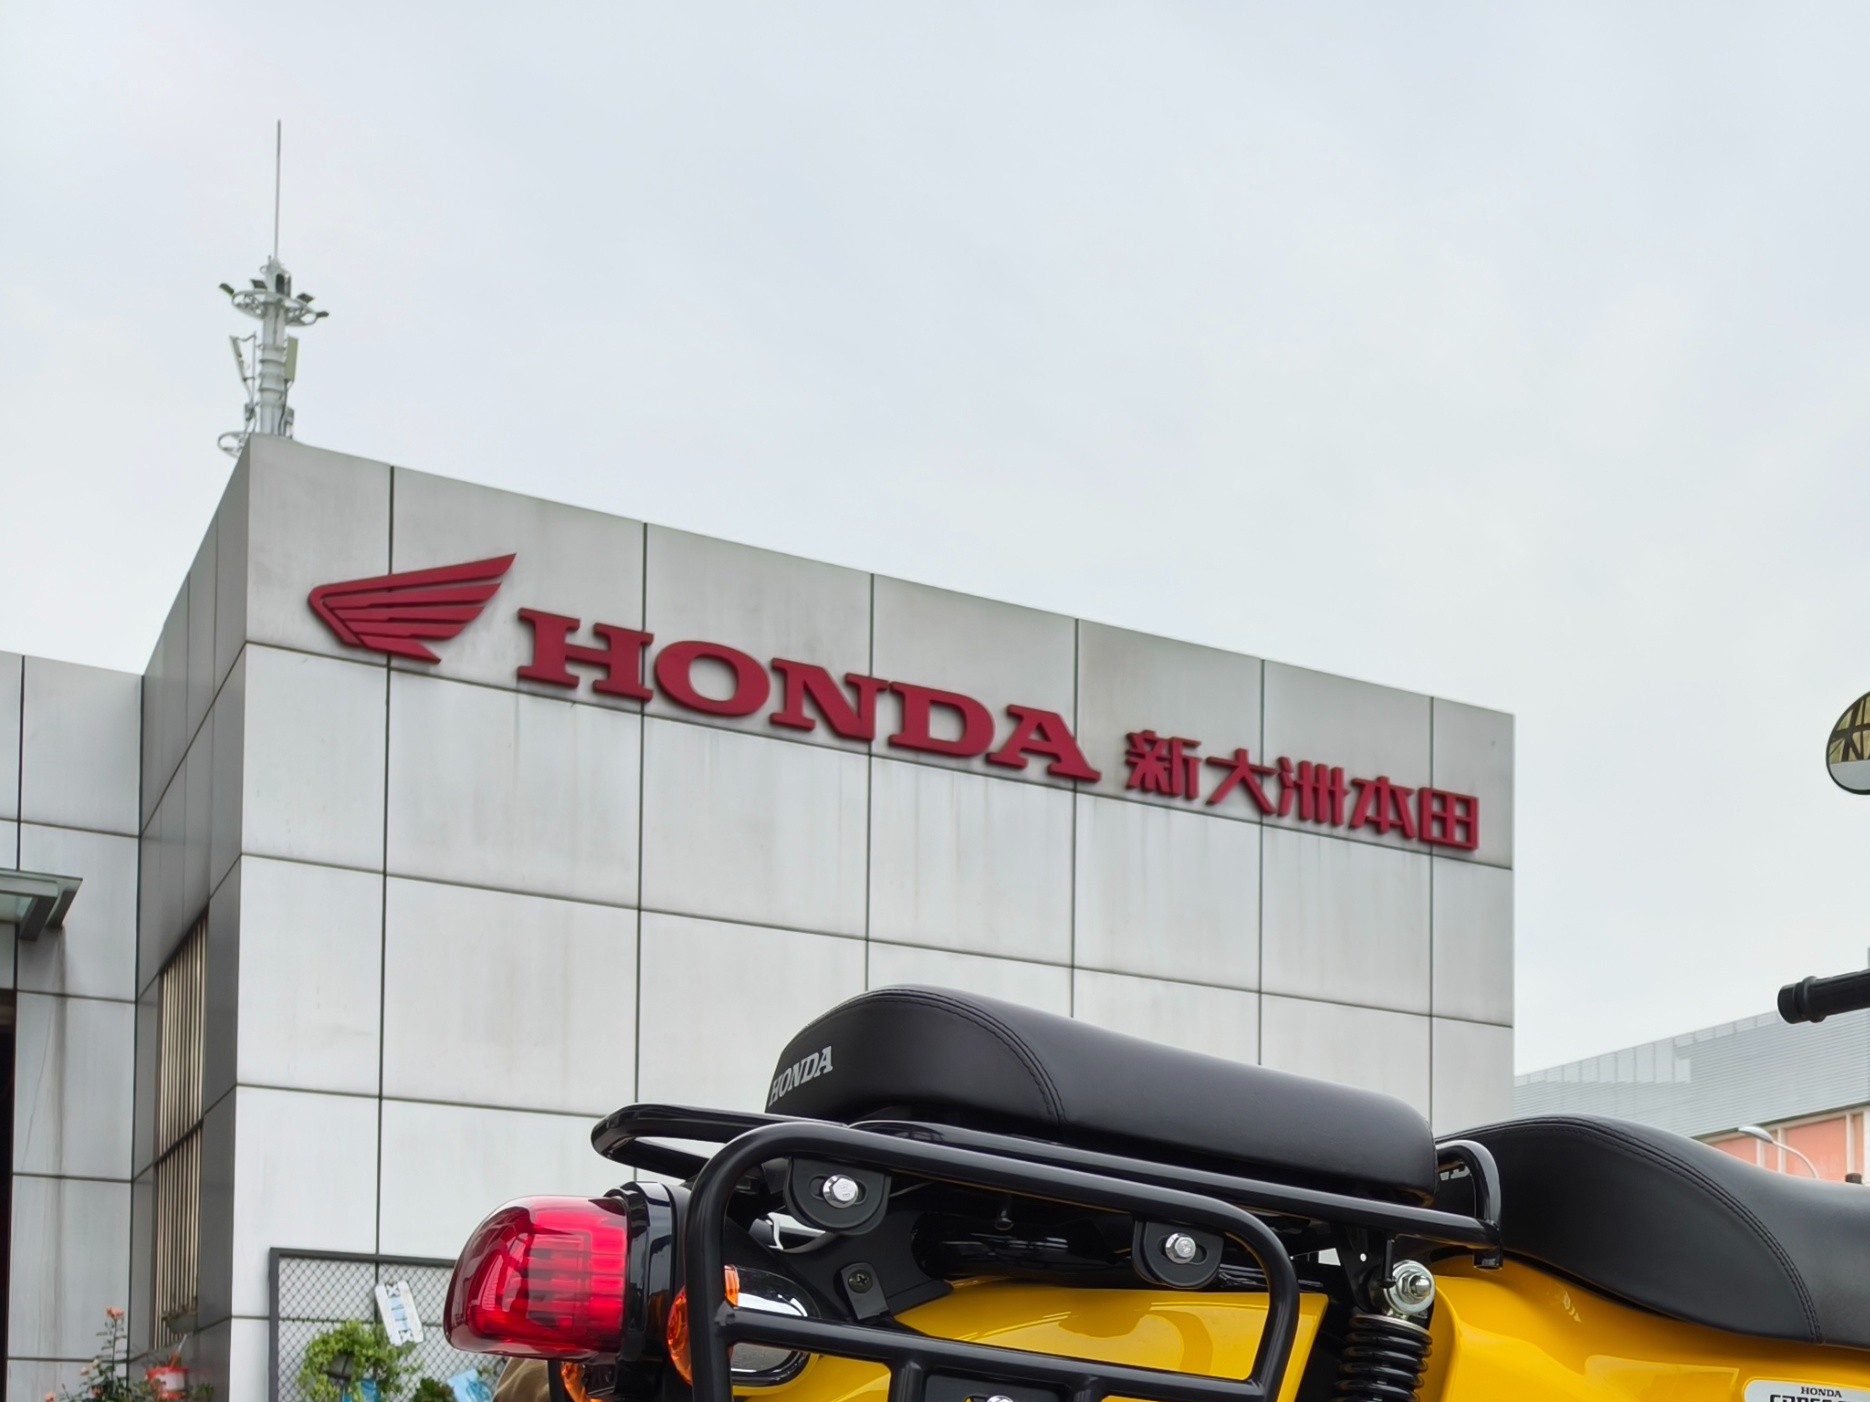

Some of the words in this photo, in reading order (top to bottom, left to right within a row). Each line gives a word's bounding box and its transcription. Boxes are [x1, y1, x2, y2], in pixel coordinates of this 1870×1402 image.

[517, 607, 1101, 783] HONDA
[1124, 729, 1480, 851] 新大洲本田
[768, 1045, 834, 1108] HONDA
[1800, 1386, 1842, 1398] HONDA
